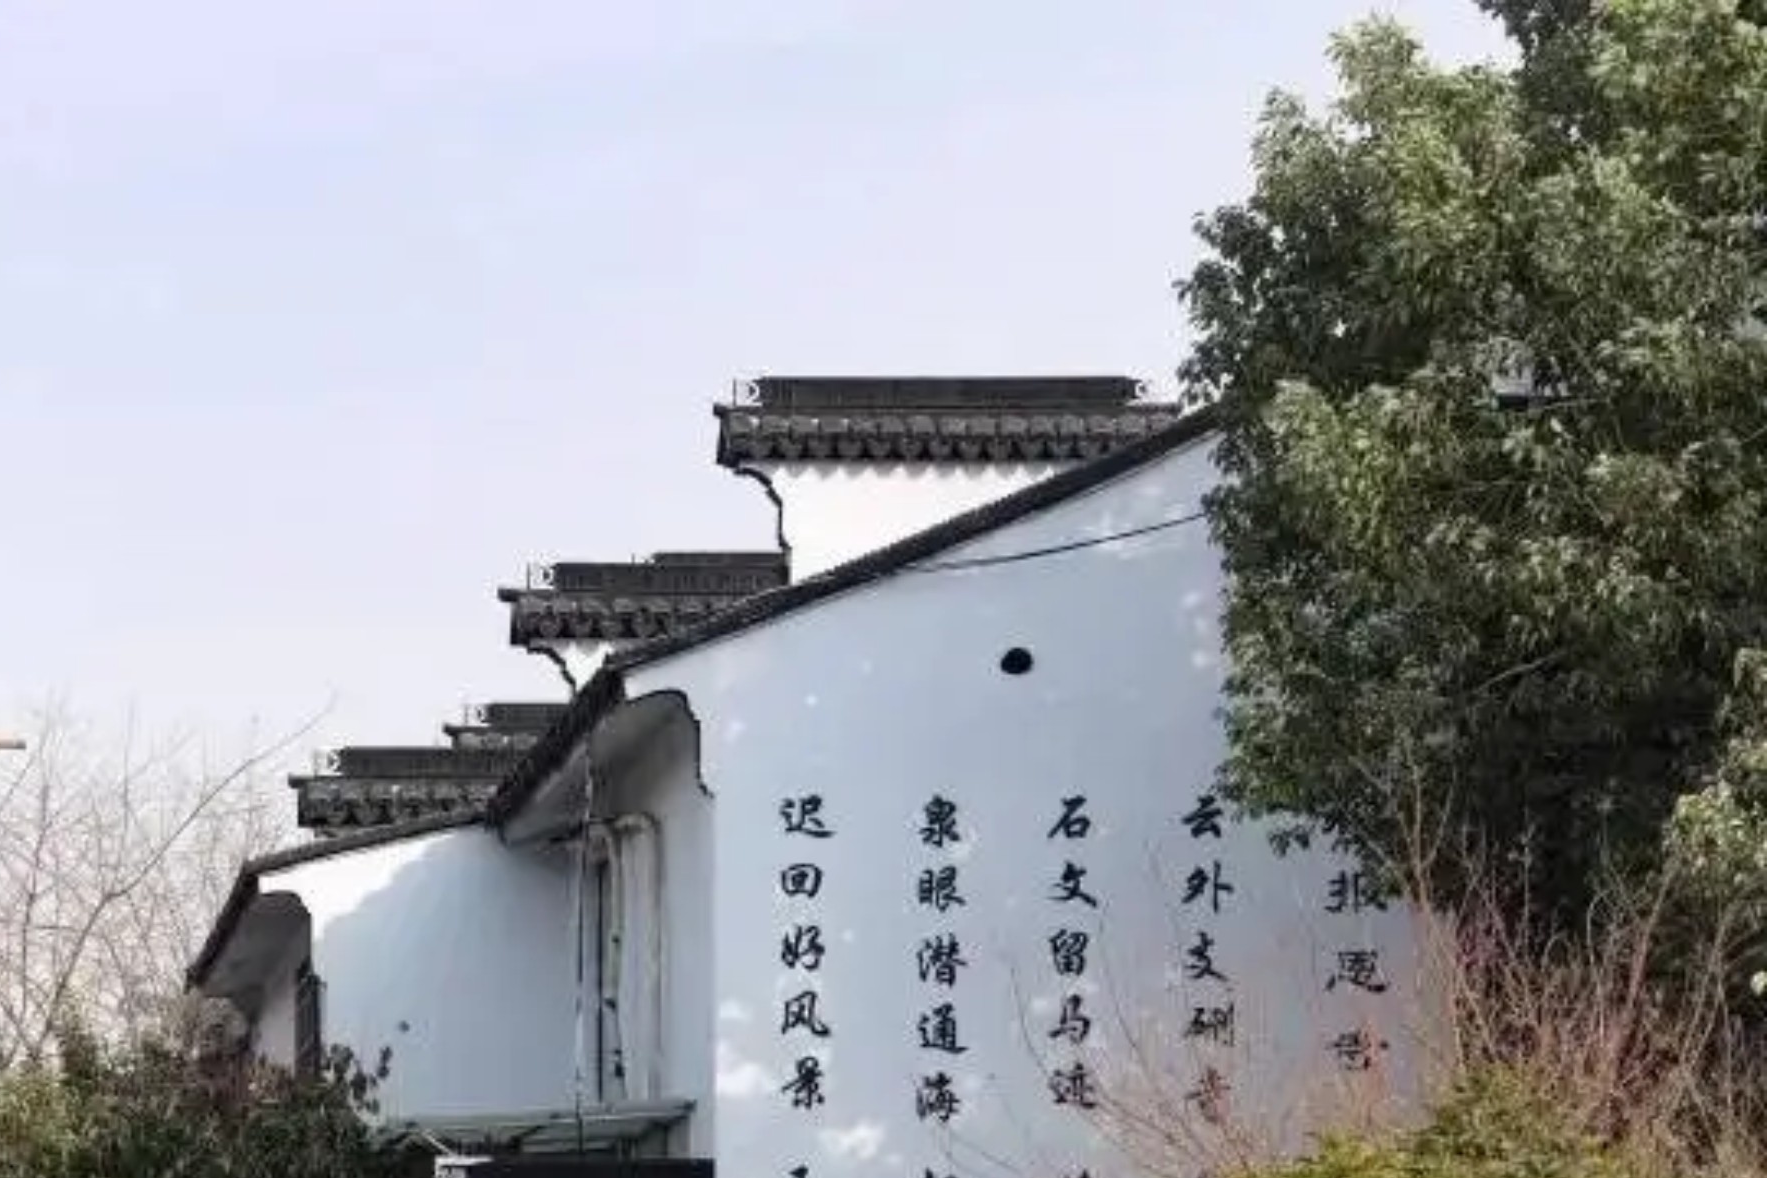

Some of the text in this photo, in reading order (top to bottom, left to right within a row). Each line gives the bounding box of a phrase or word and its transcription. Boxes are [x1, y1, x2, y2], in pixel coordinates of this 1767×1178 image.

[779, 794, 835, 1110] 迟回好风景
[915, 795, 968, 1123] 泉眼潜通海
[1047, 795, 1100, 1110] 石文留马迹
